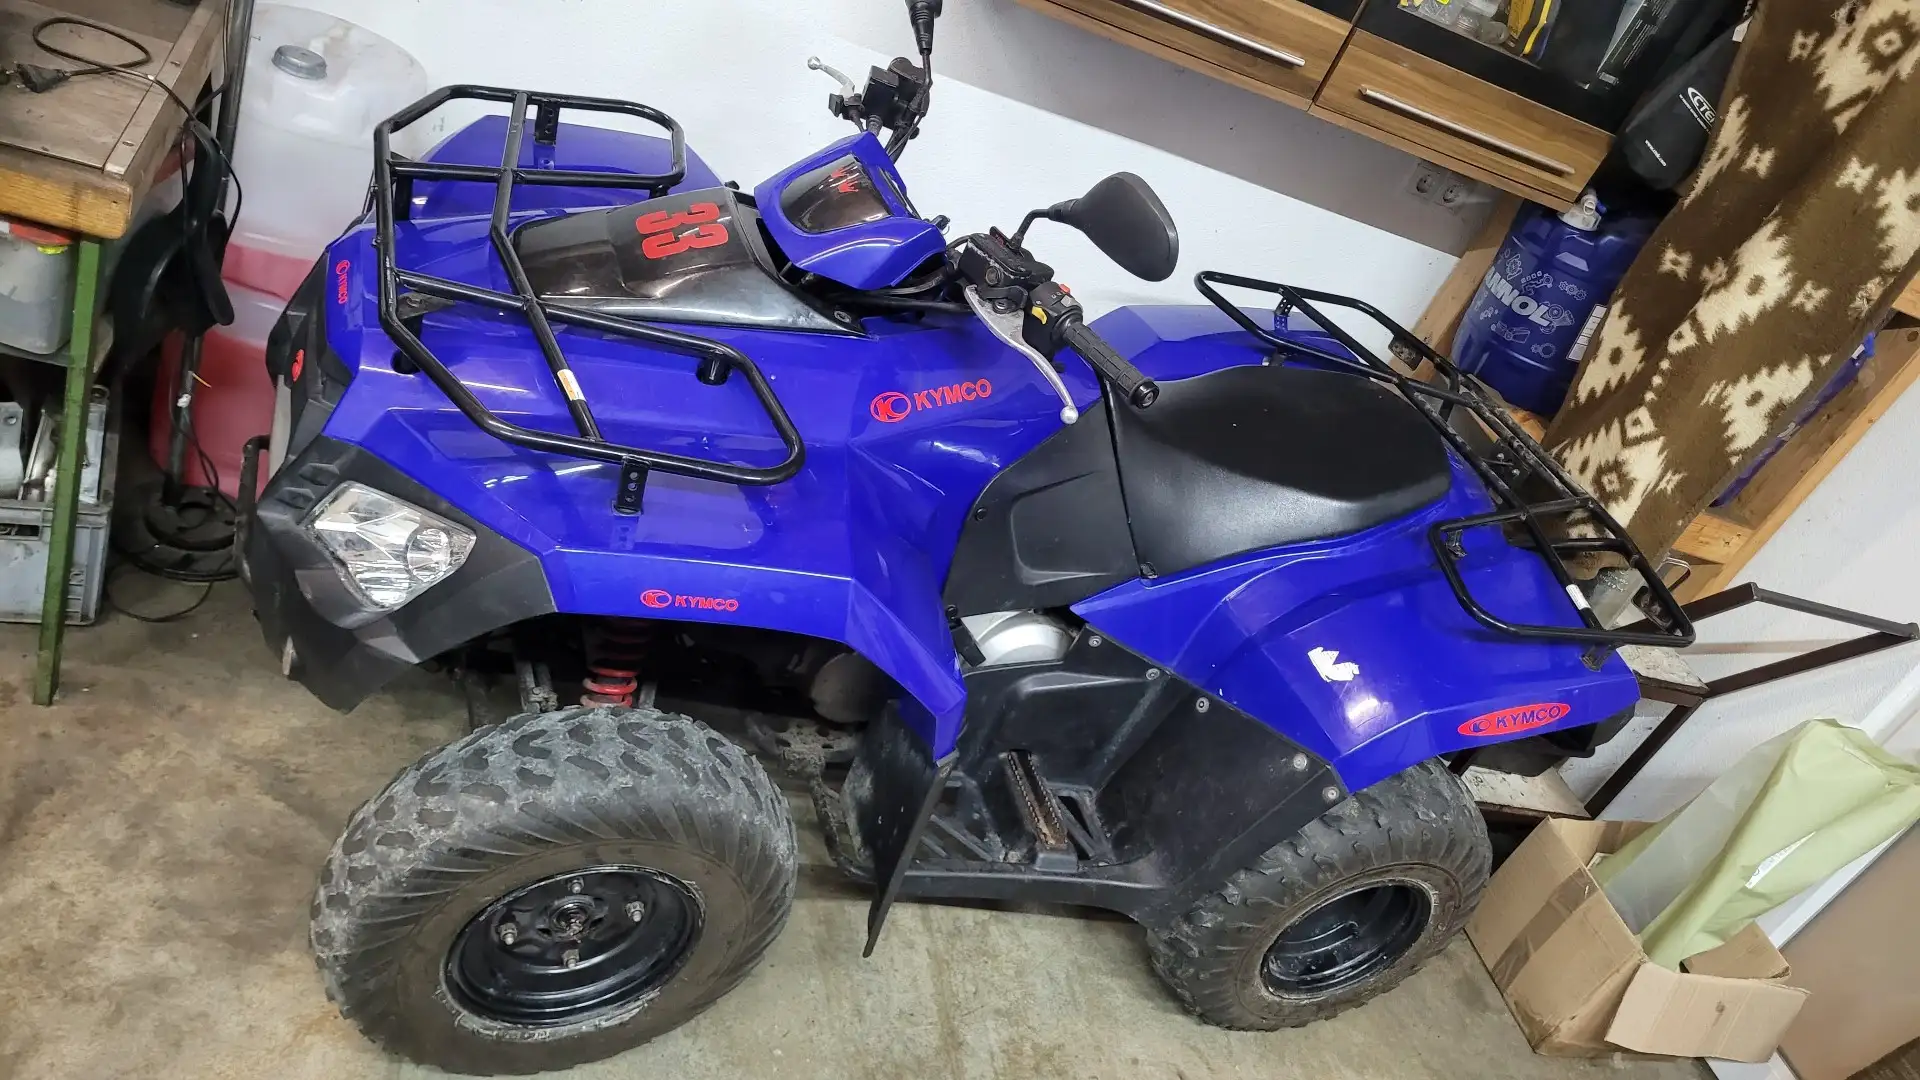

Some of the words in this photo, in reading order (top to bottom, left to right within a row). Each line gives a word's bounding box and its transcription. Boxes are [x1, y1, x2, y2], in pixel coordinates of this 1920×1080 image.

[635, 202, 729, 259] 33
[913, 378, 992, 411] KYMCO
[674, 594, 739, 612] KYMCO
[1495, 705, 1561, 729] KYMCO
